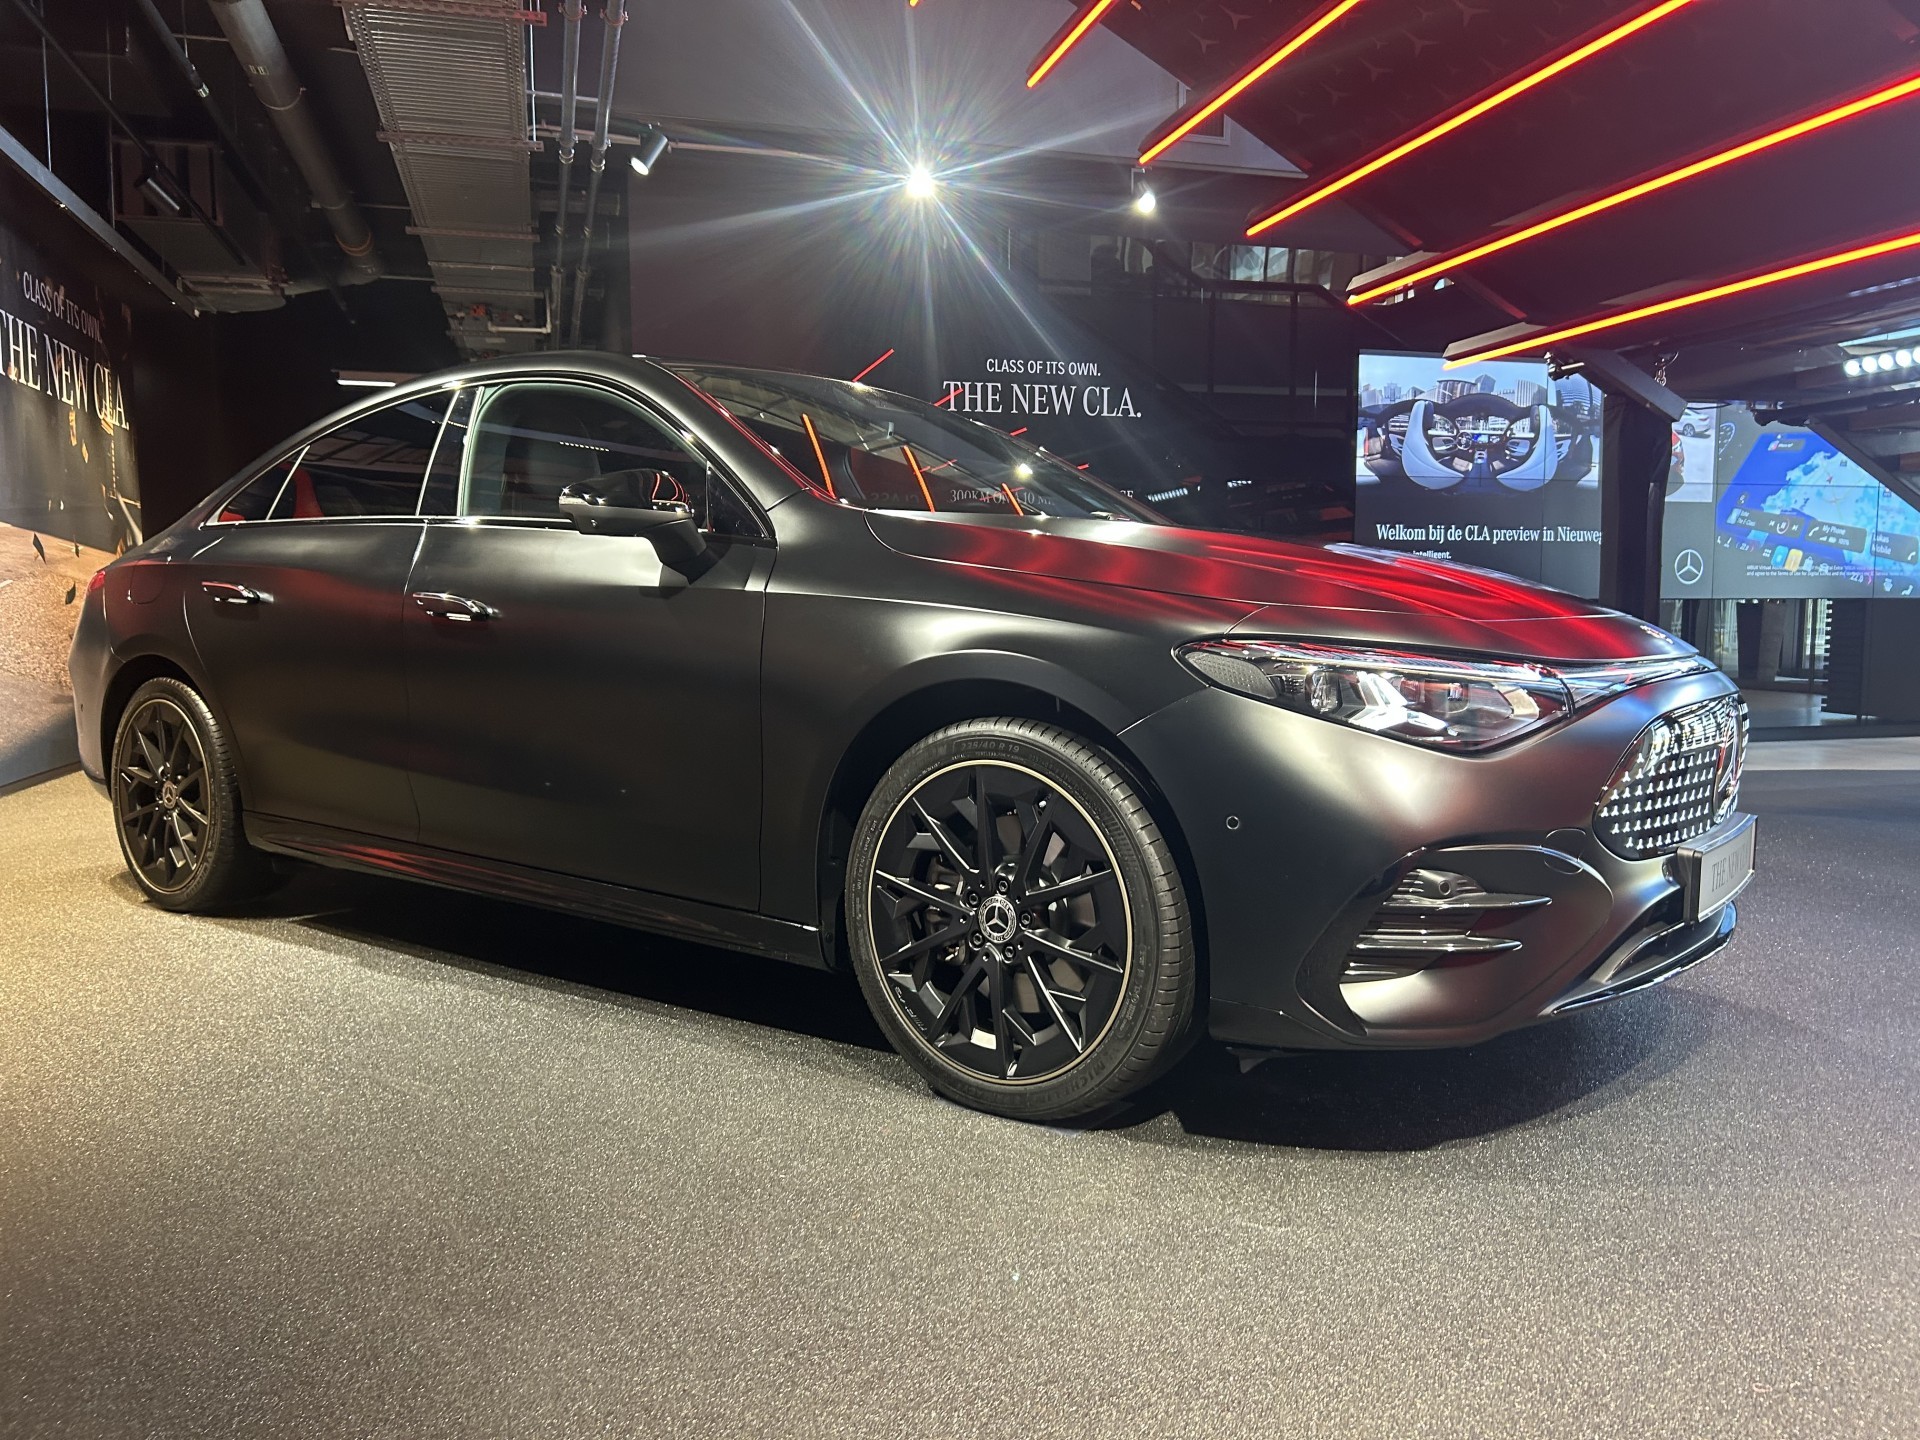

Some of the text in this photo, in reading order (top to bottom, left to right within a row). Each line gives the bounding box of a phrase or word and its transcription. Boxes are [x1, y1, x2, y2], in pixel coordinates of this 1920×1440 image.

[24, 272, 52, 312] CLASS
[54, 291, 65, 319] OF
[66, 299, 80, 329] ITS
[44, 333, 89, 412] NEW
[94, 363, 129, 430] CLA.
[986, 358, 1101, 376] CLASS OF ITS OWN.
[943, 381, 1142, 418] THE NEW CLA.
[1376, 524, 1602, 545] Welkom bij de CLA preview in Nieuwe
[1009, 744, 1020, 753] 19
[1711, 857, 1726, 892] THE
